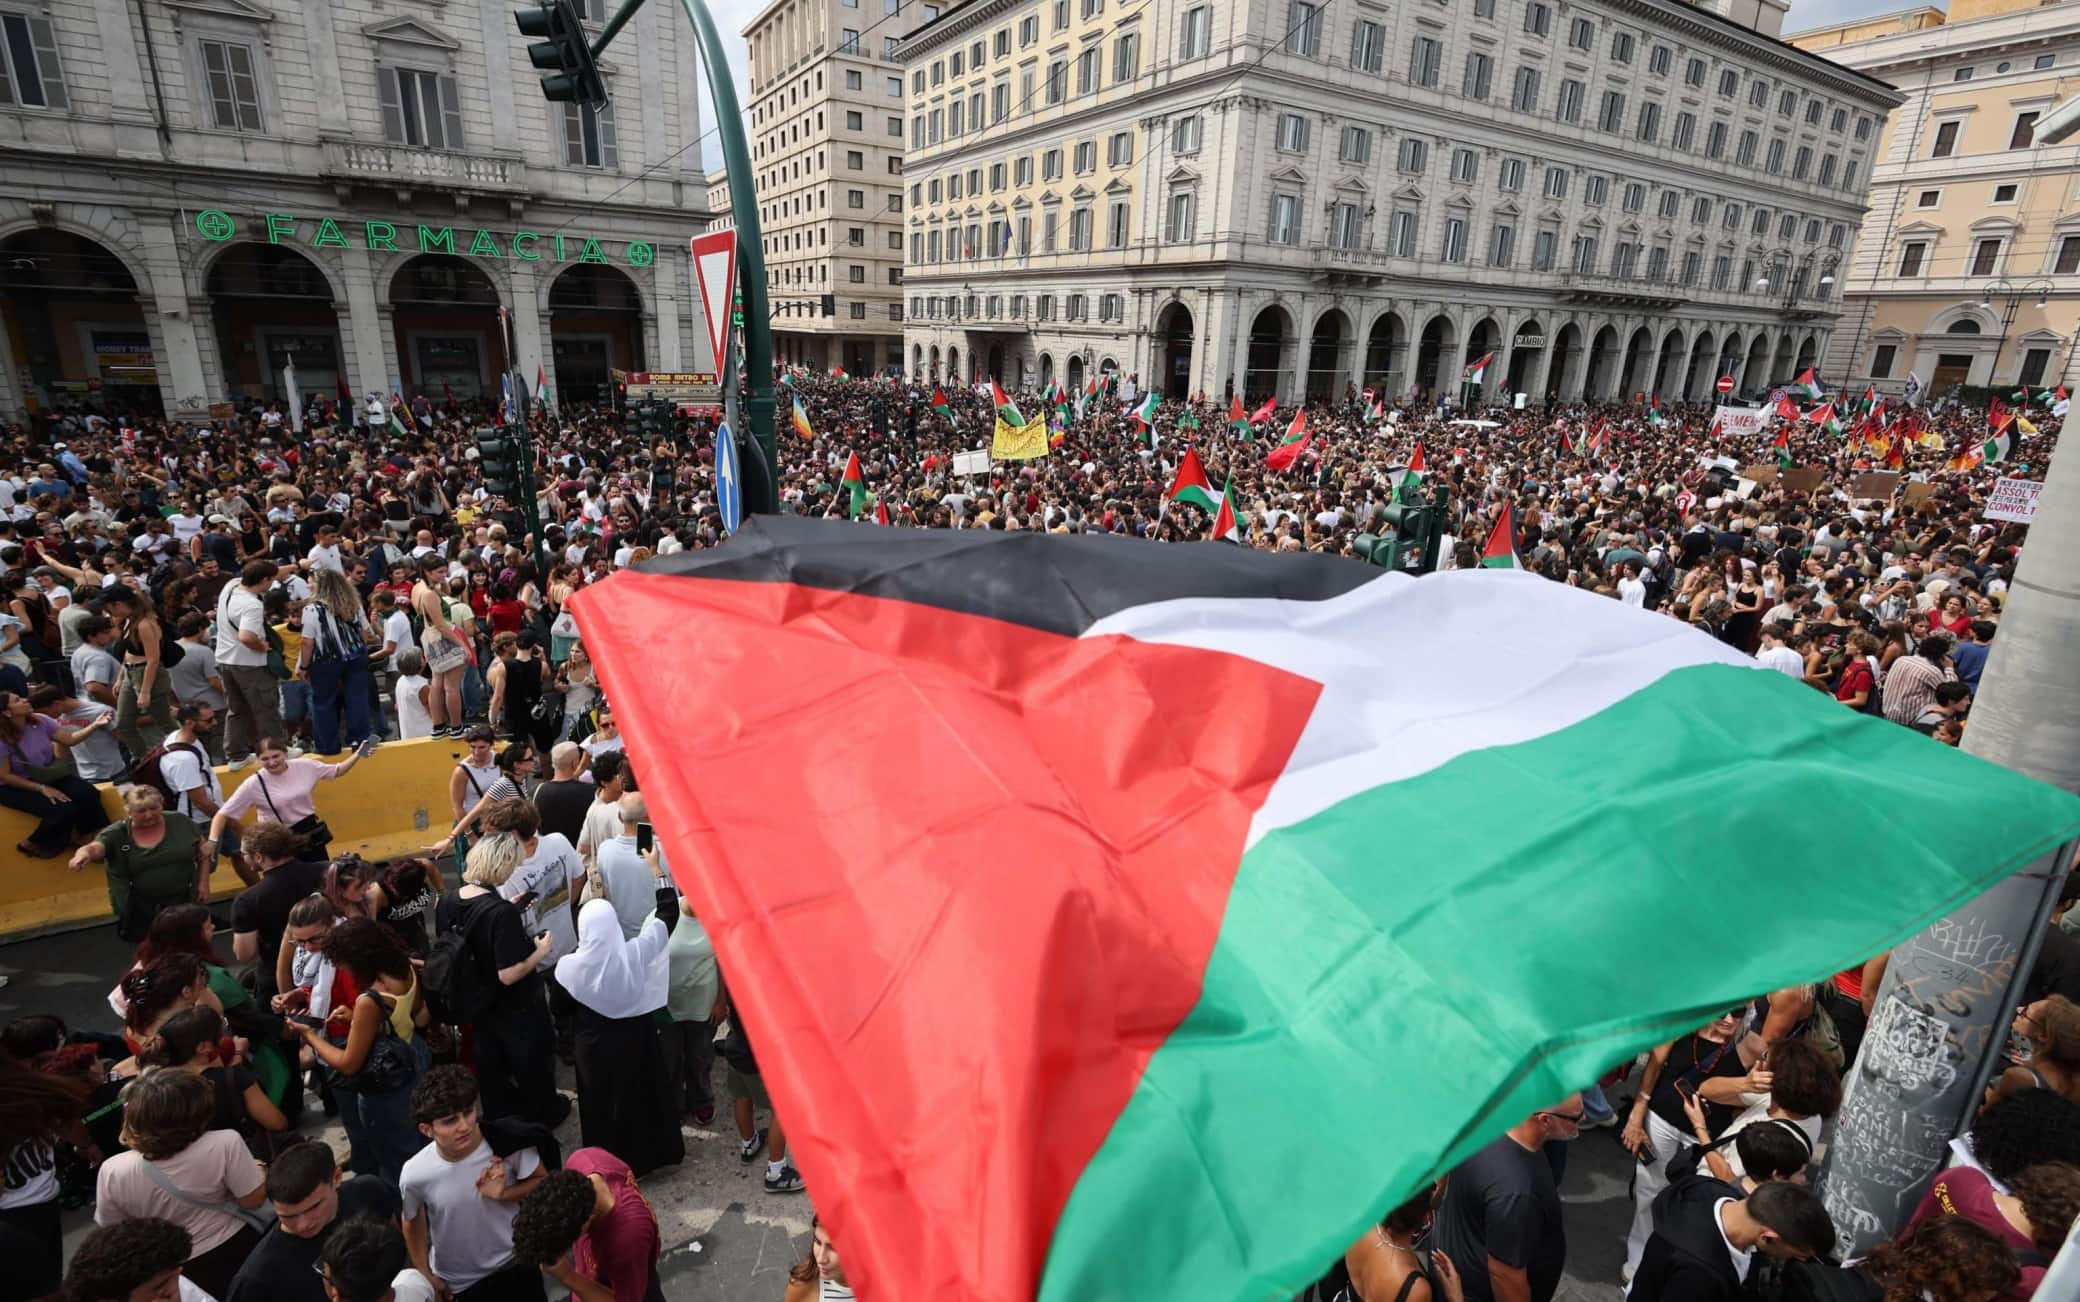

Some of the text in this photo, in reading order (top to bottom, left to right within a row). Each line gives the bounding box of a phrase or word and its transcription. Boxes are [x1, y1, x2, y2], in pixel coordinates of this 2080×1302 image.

[265, 213, 609, 265] FARMACIA
[1515, 336, 1545, 346] CAMBIO
[1988, 501, 2037, 516] COINVOLT
